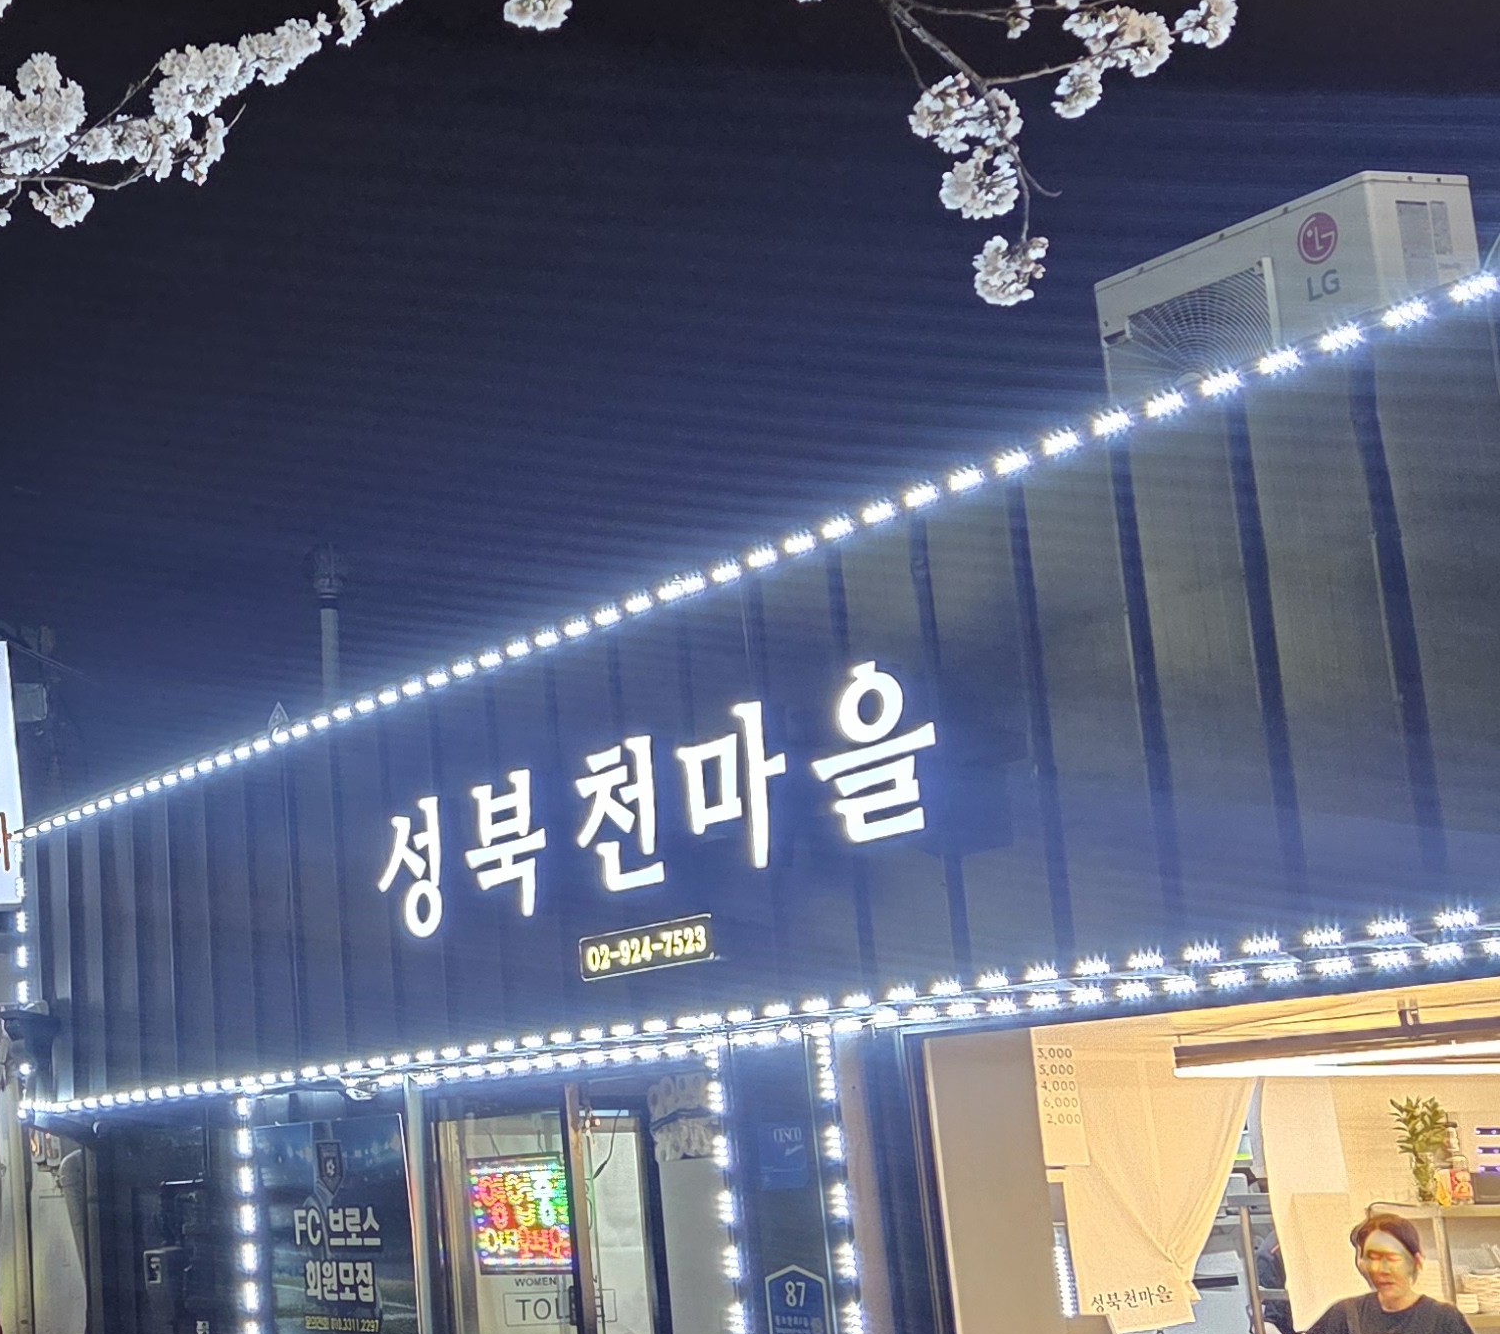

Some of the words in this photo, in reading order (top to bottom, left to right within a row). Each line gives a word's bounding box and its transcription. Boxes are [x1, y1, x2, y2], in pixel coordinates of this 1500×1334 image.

[1307, 269, 1341, 302] LG
[378, 660, 937, 938] 성북천마을
[586, 925, 707, 972] 02-924-7523
[293, 1208, 323, 1246] FC
[328, 1206, 382, 1247] 브로스
[304, 1259, 375, 1303] 회원모집
[514, 1276, 557, 1288] WOMEN
[784, 1280, 806, 1308] 87
[1091, 1284, 1174, 1313] 성북천마을
